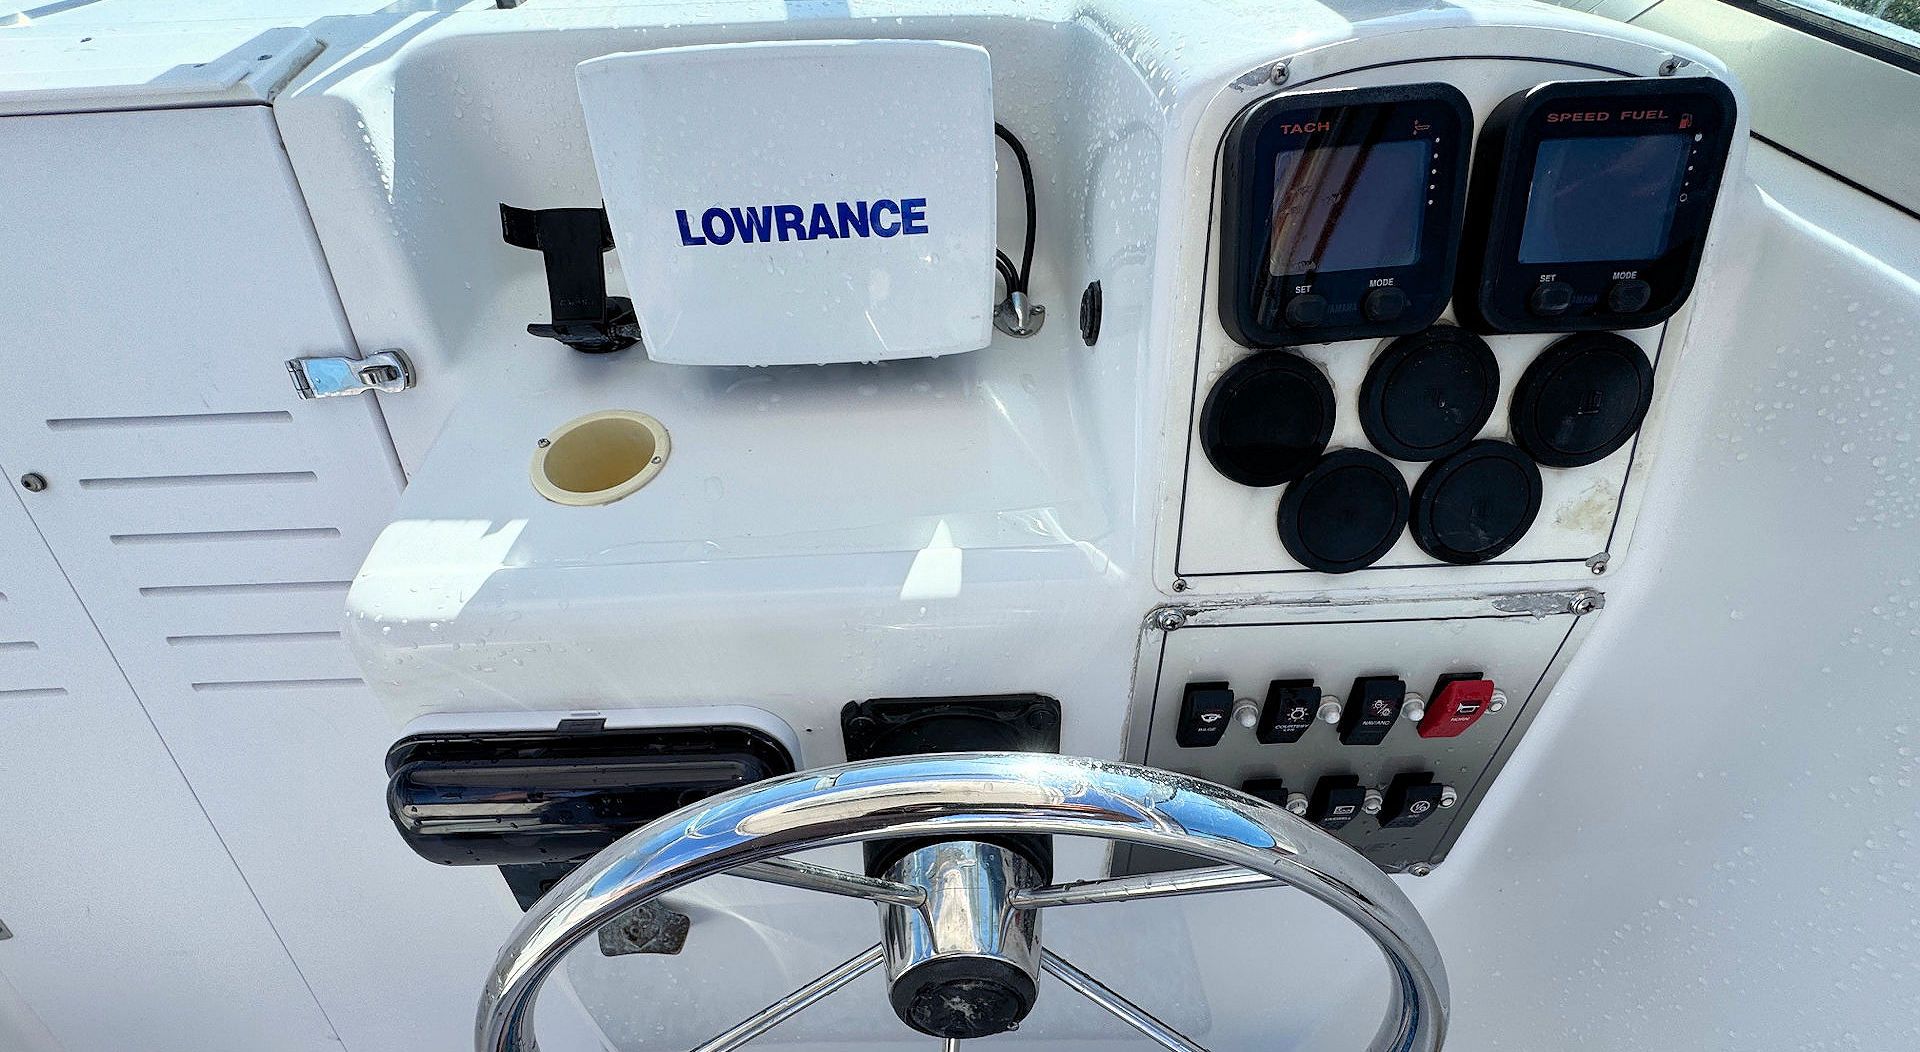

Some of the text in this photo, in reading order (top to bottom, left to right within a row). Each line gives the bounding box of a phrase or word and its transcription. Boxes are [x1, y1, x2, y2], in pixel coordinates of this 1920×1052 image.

[1546, 110, 1669, 123] SPEED FUEL
[1280, 122, 1330, 135] TACH
[675, 198, 928, 246] LOWRANCE
[1539, 274, 1557, 283] SET
[1612, 271, 1638, 280] MODE
[1369, 278, 1394, 287] MODE
[1295, 285, 1312, 294] SET
